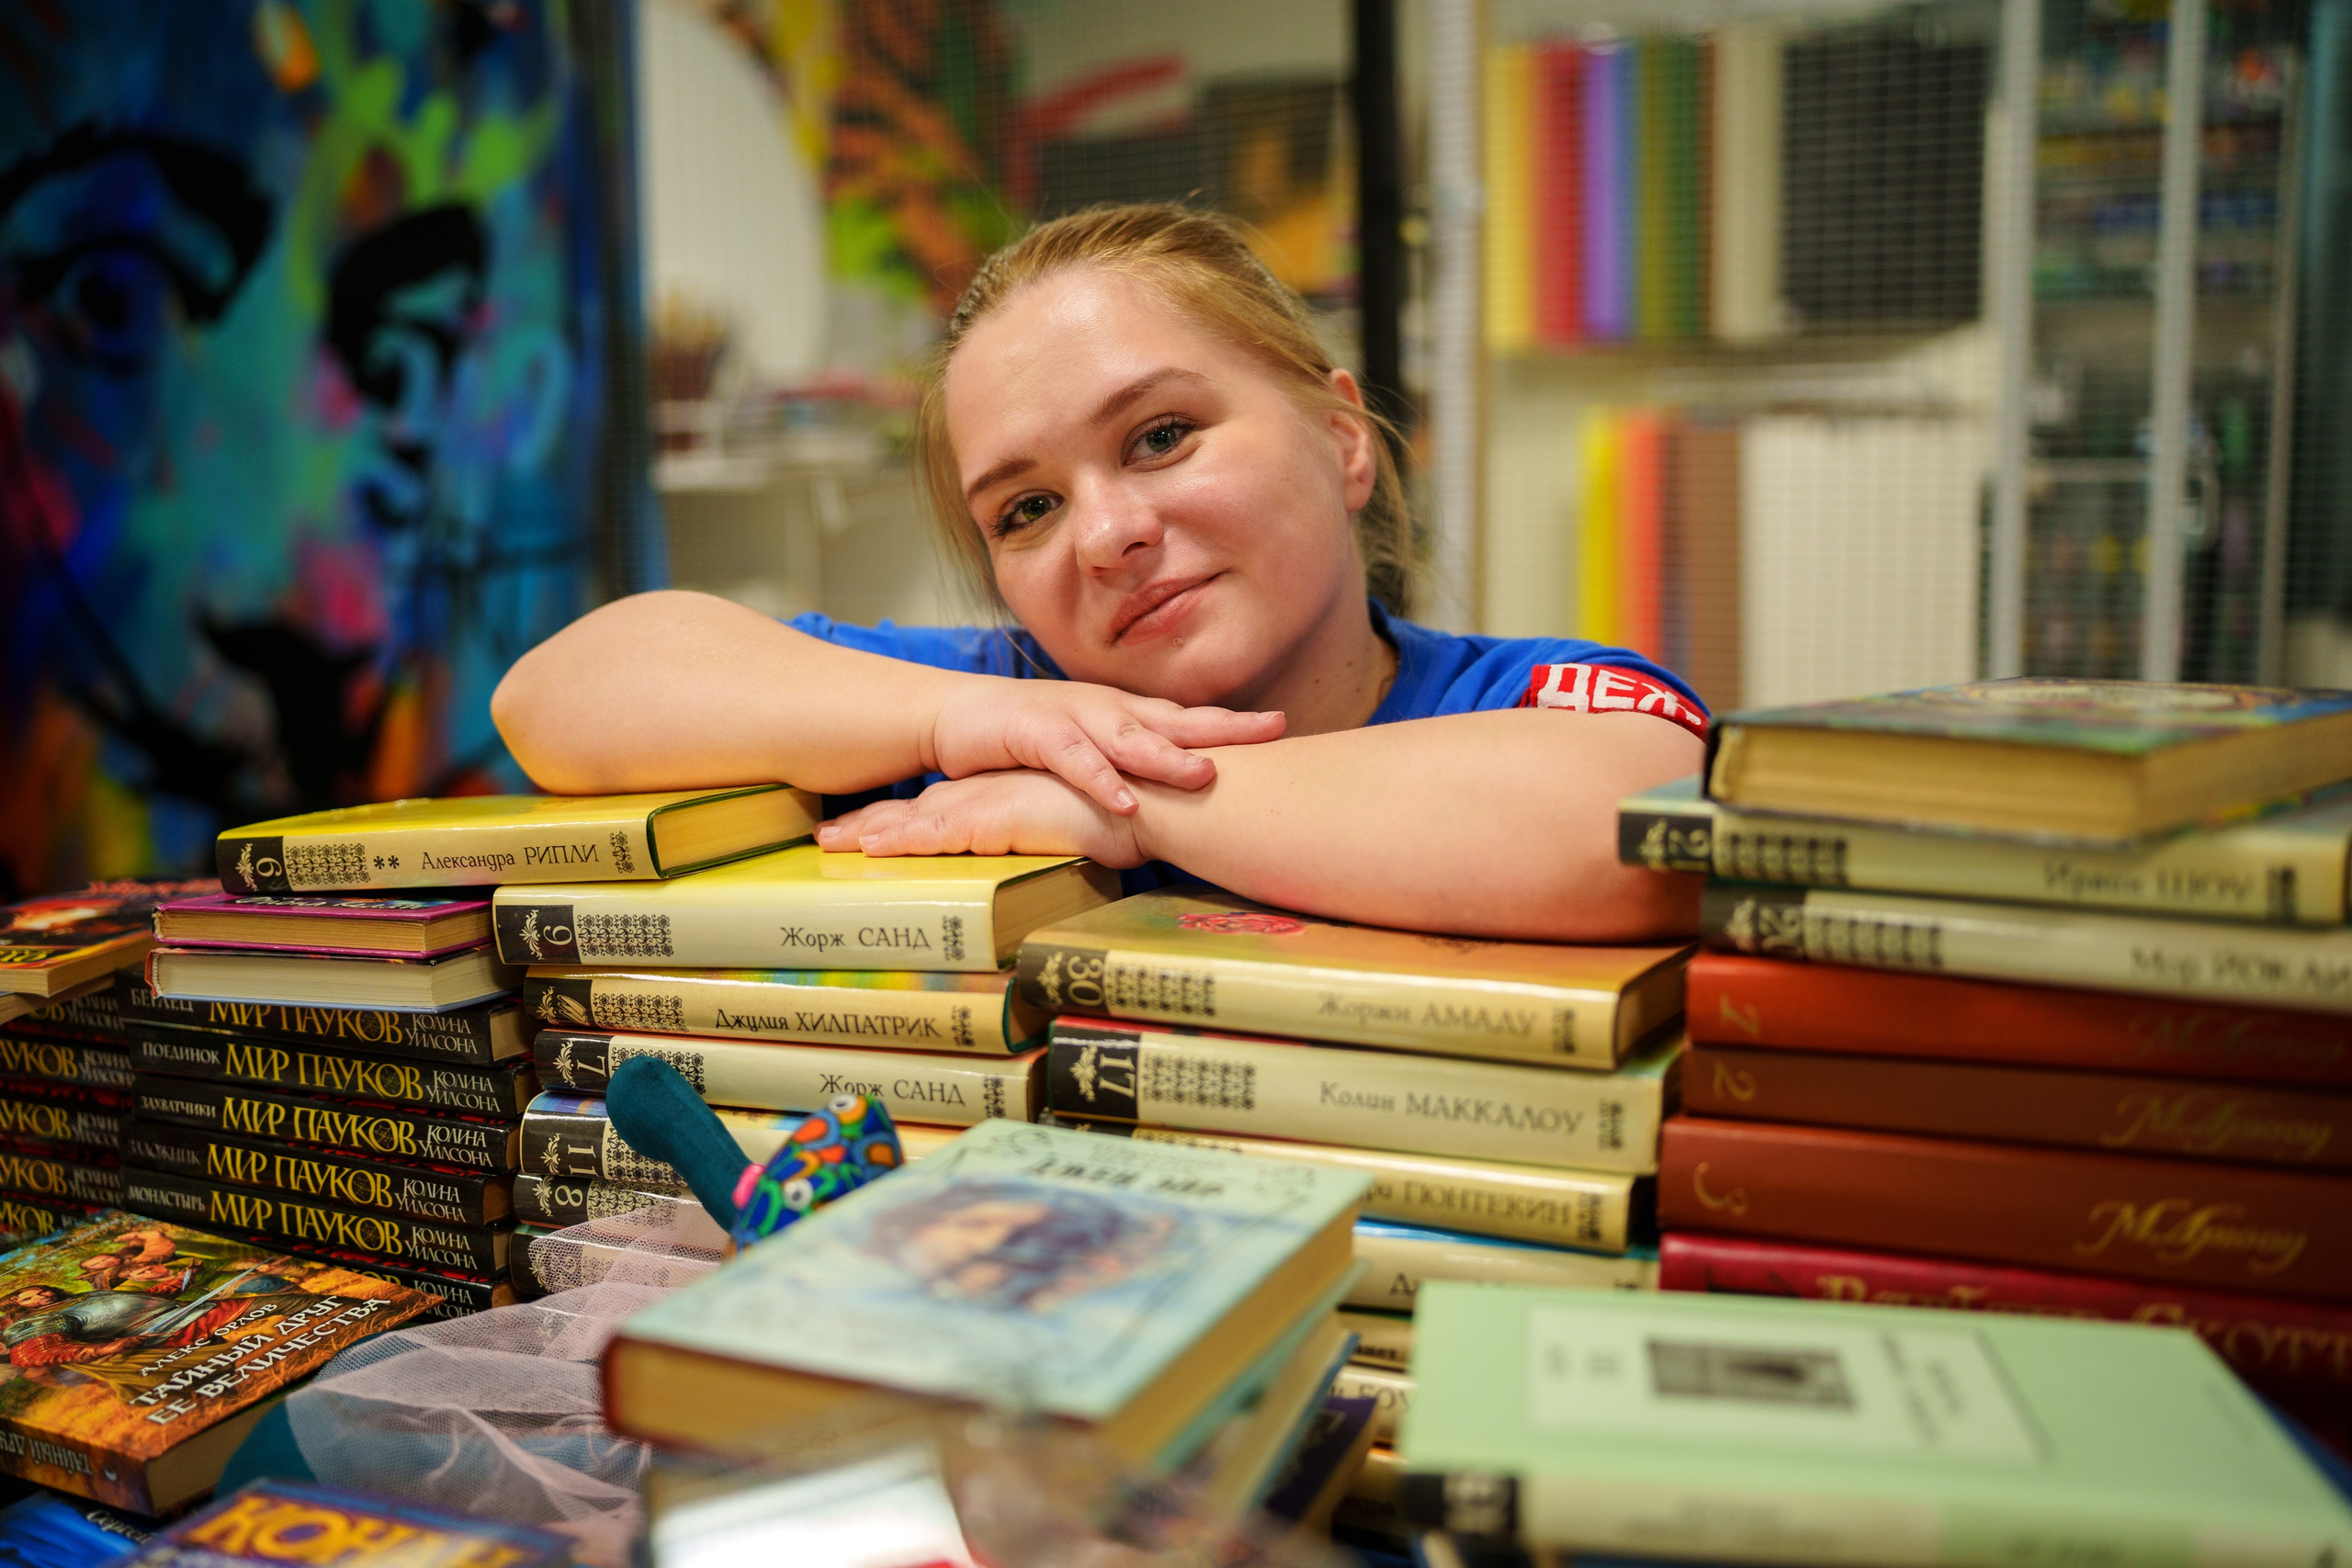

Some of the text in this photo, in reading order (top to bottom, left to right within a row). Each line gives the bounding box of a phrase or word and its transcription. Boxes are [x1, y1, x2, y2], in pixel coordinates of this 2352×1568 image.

[422, 843, 600, 872] Александра РИПЛИ
[780, 927, 932, 952] Жорж САНД
[1067, 955, 1105, 1007] 30
[280, 1006, 403, 1044] ПАУКОВ
[413, 1012, 471, 1034] КОЛИНА
[716, 1009, 943, 1038] Джулия ХИЛПАТРИК
[405, 1027, 479, 1055] УИЛСОНА
[142, 1041, 424, 1100] ПОЕДИНОК МИР ПАУКОВ
[432, 1069, 494, 1093] КОЛИНА
[1099, 1053, 1136, 1100] 17
[425, 1085, 502, 1112] УИЛСОНА
[820, 1073, 967, 1107] Жорж САНД
[140, 1095, 417, 1156] ЗАХВАТЧИКИ МИР ПАУКОВ
[427, 1124, 487, 1148] КОЛИНА
[418, 1139, 494, 1168] УИЛСОНА
[207, 1143, 267, 1184] МИР
[274, 1154, 393, 1208] ПАУКОВ
[402, 1178, 461, 1203] КОЛИНА
[395, 1192, 467, 1223] УИЛСОНА
[554, 1184, 583, 1207] 8
[129, 1185, 403, 1255] МОНАСТЫРЬ МИР ПАУКОВ
[412, 1225, 471, 1251] КОЛИНА
[405, 1240, 478, 1270] УИЛСОНА
[129, 1295, 344, 1407] ТАЙНЫЙ ДРУГ
[140, 1303, 278, 1377] АЛЕКС ОРЛОВ
[146, 1297, 391, 1425] ЕЕ ВЕЛИЧЕСТВА
[28, 1438, 94, 1476] ТАЙНЫЙ
